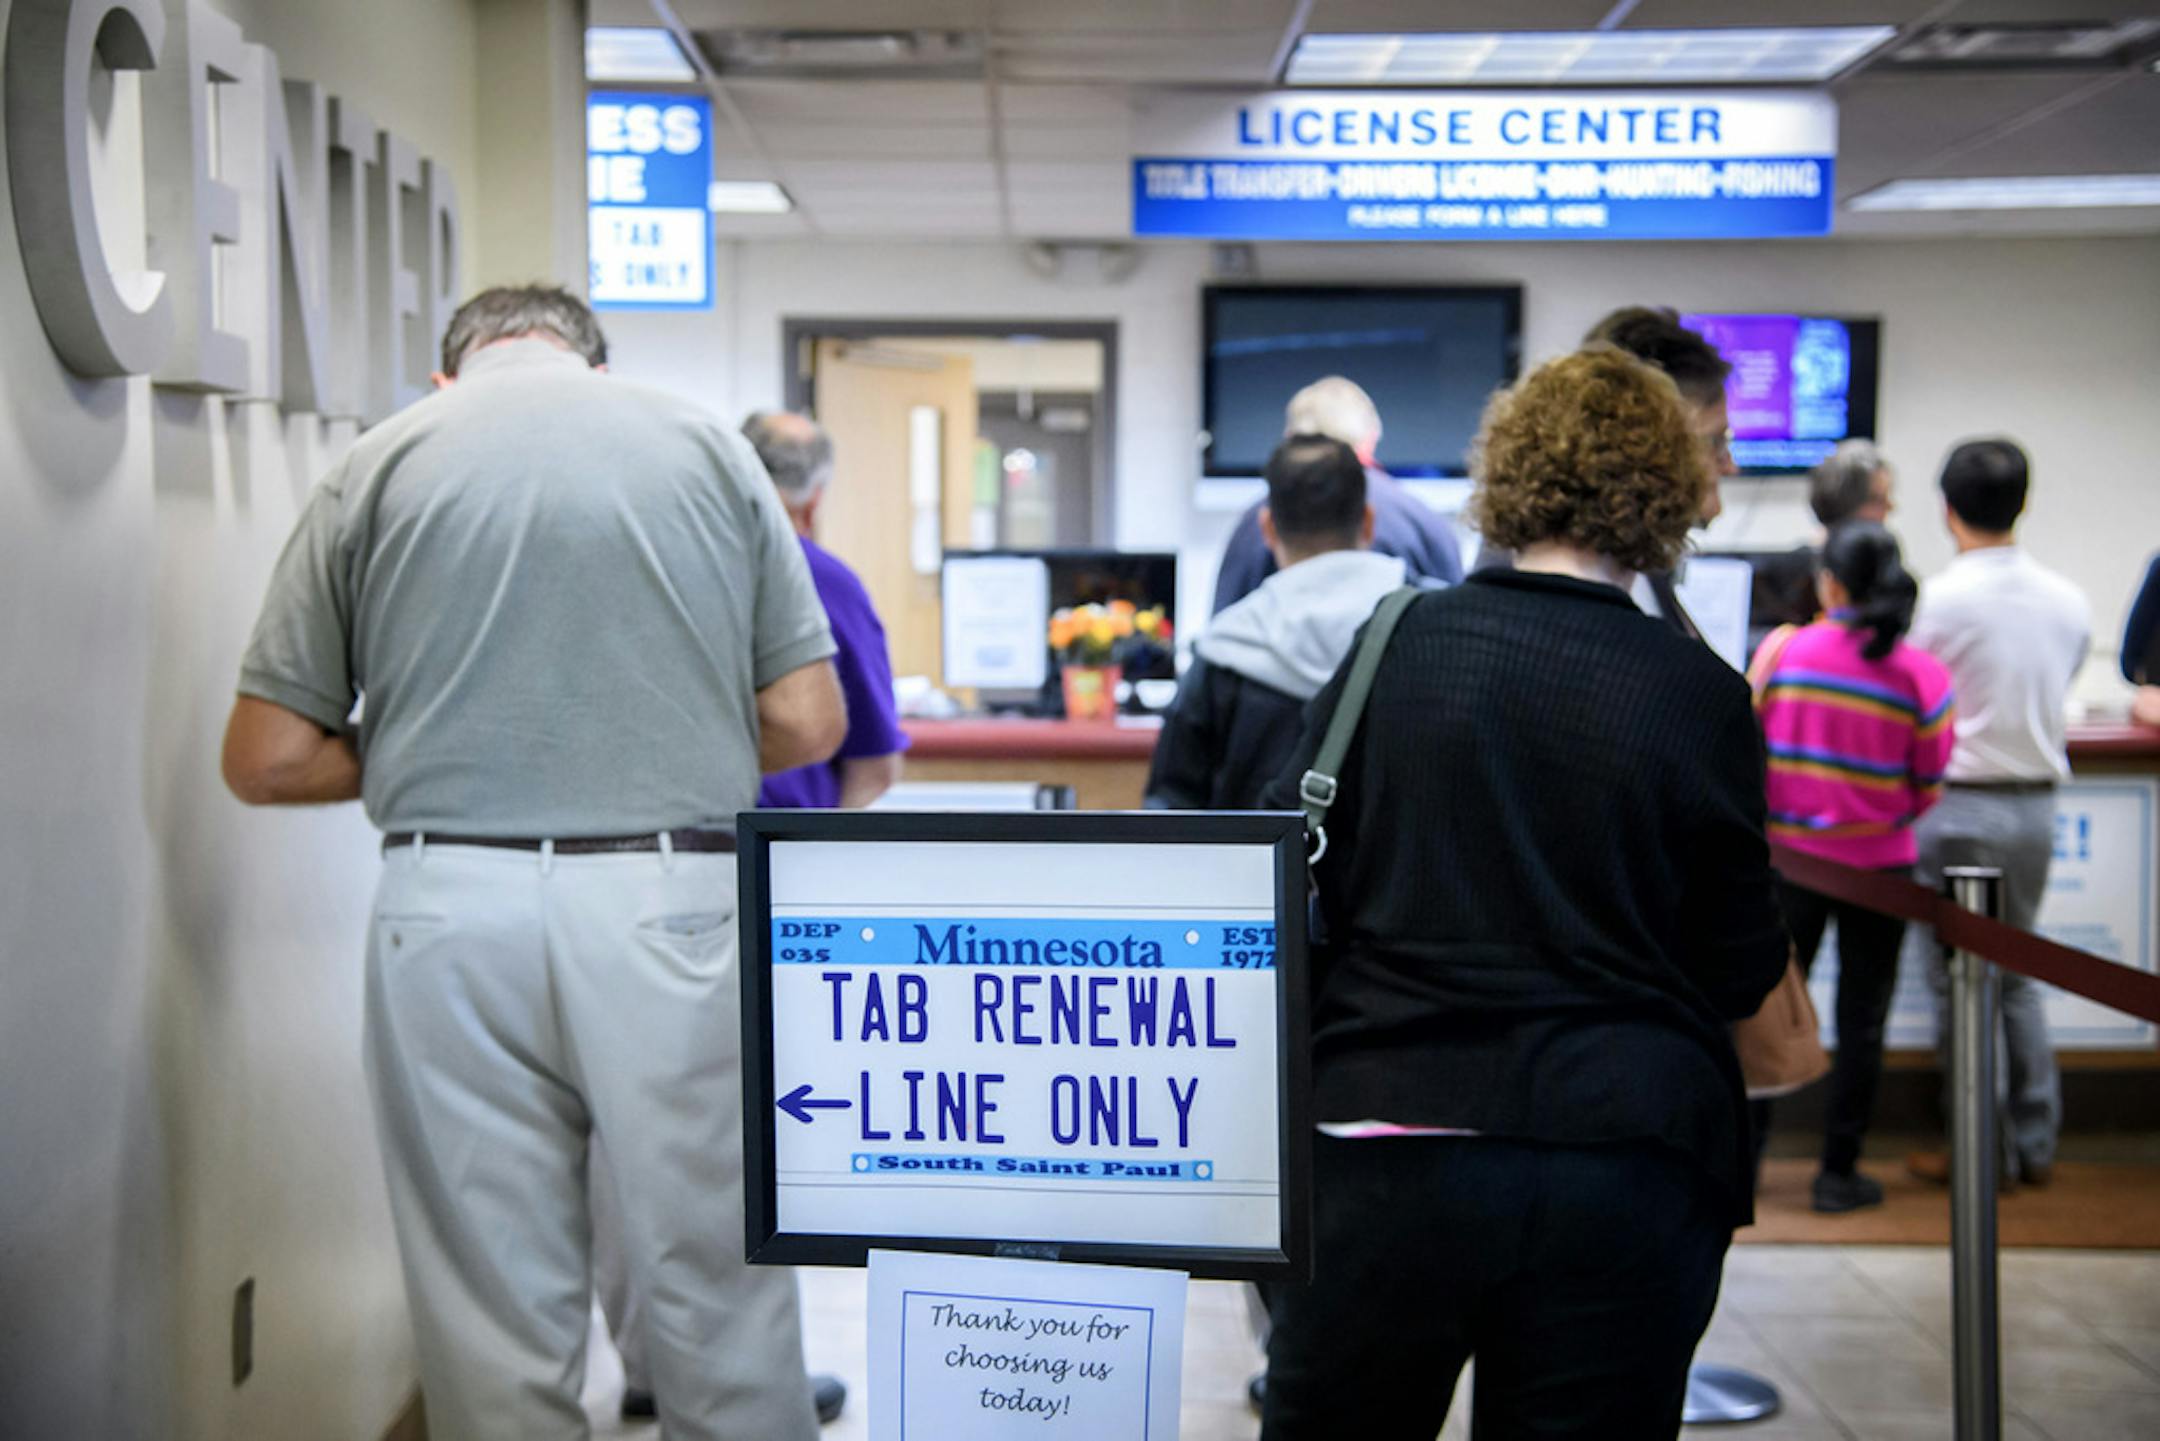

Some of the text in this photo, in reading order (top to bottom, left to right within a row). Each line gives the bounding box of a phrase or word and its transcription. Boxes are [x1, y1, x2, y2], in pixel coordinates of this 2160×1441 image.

[1237, 107, 1722, 147] LICENSE CENTER
[780, 923, 842, 938] DEP
[914, 924, 1165, 968] Minnesota
[1222, 927, 1277, 946] EST
[780, 948, 831, 963] 035
[1221, 949, 1277, 969] 1972
[822, 972, 1237, 1049] TAB RENEWAL
[860, 1071, 1199, 1148] LINE ONLY
[877, 1155, 1181, 1178] South Saint Paul
[930, 1303, 1130, 1343] Thank you for
[944, 1344, 1114, 1383] choosing us
[980, 1387, 1071, 1421] today!
